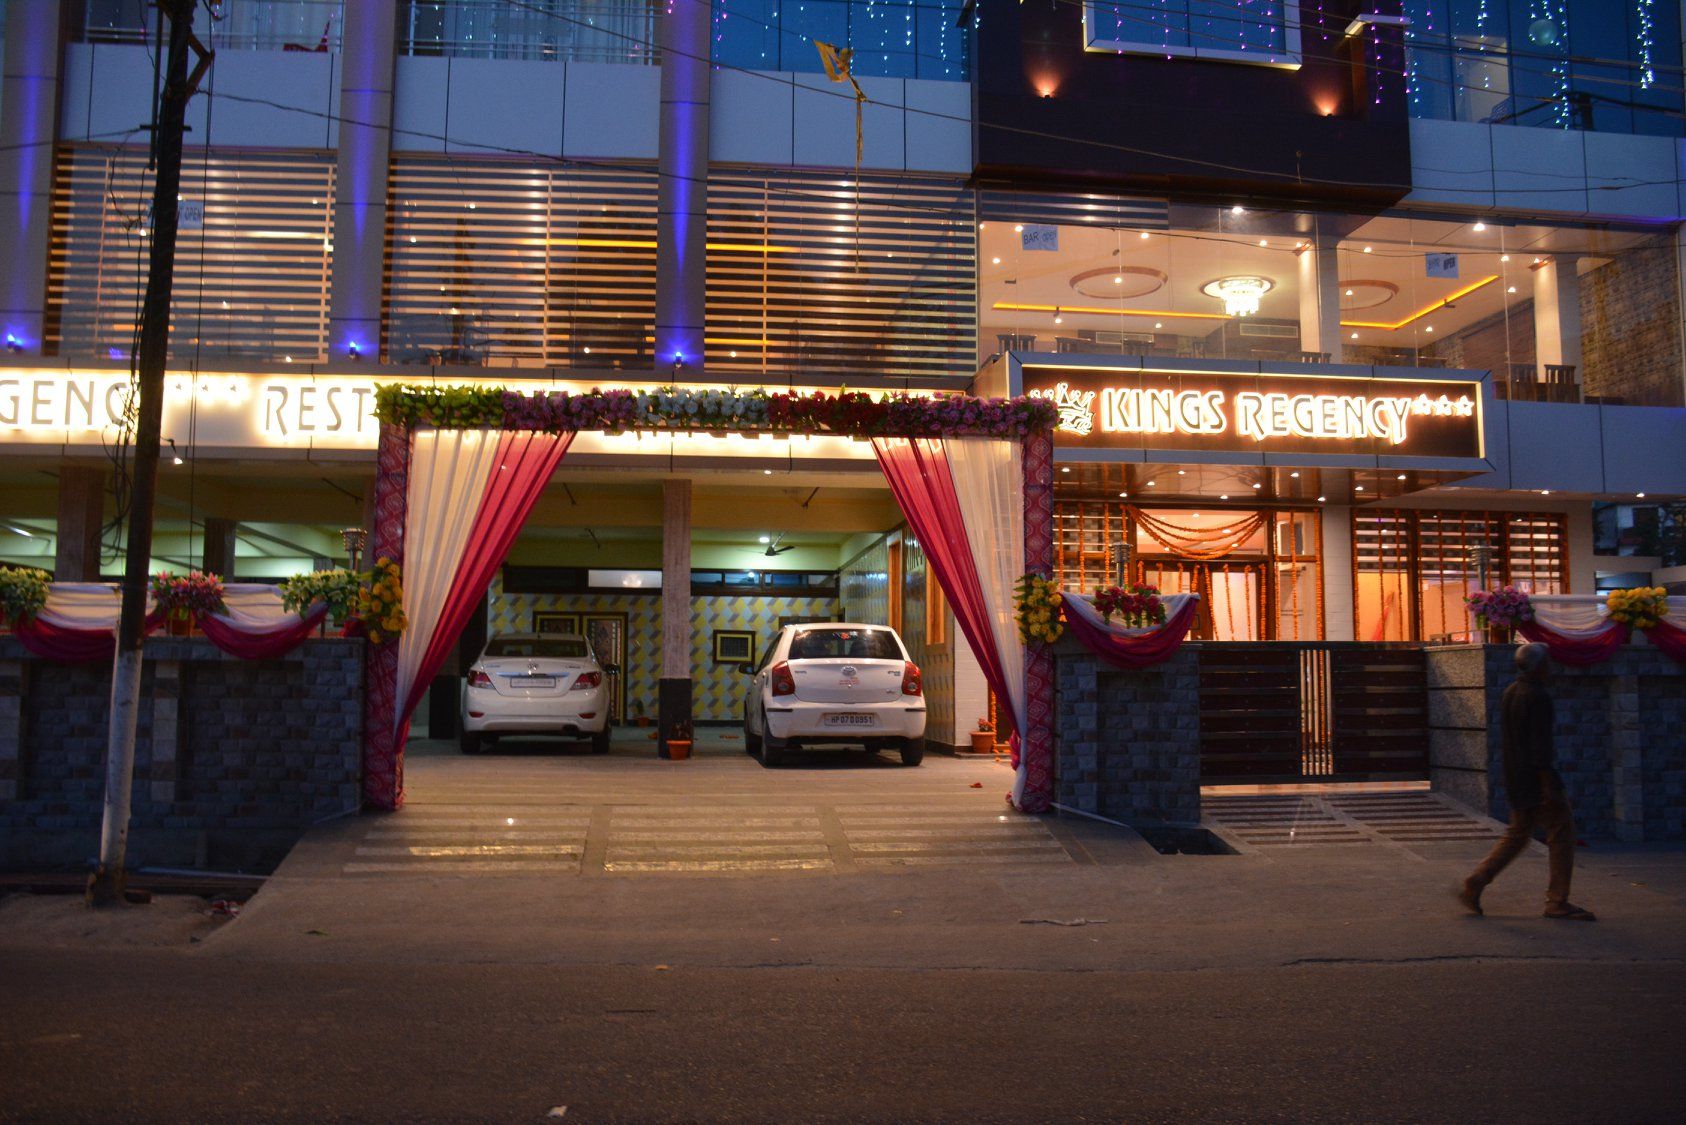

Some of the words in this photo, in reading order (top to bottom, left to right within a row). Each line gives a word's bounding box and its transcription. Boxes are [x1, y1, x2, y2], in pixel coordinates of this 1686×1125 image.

[1023, 231, 1040, 245] BAR
[1101, 387, 1228, 434] KINGS
[1237, 392, 1411, 444] REGENCY
